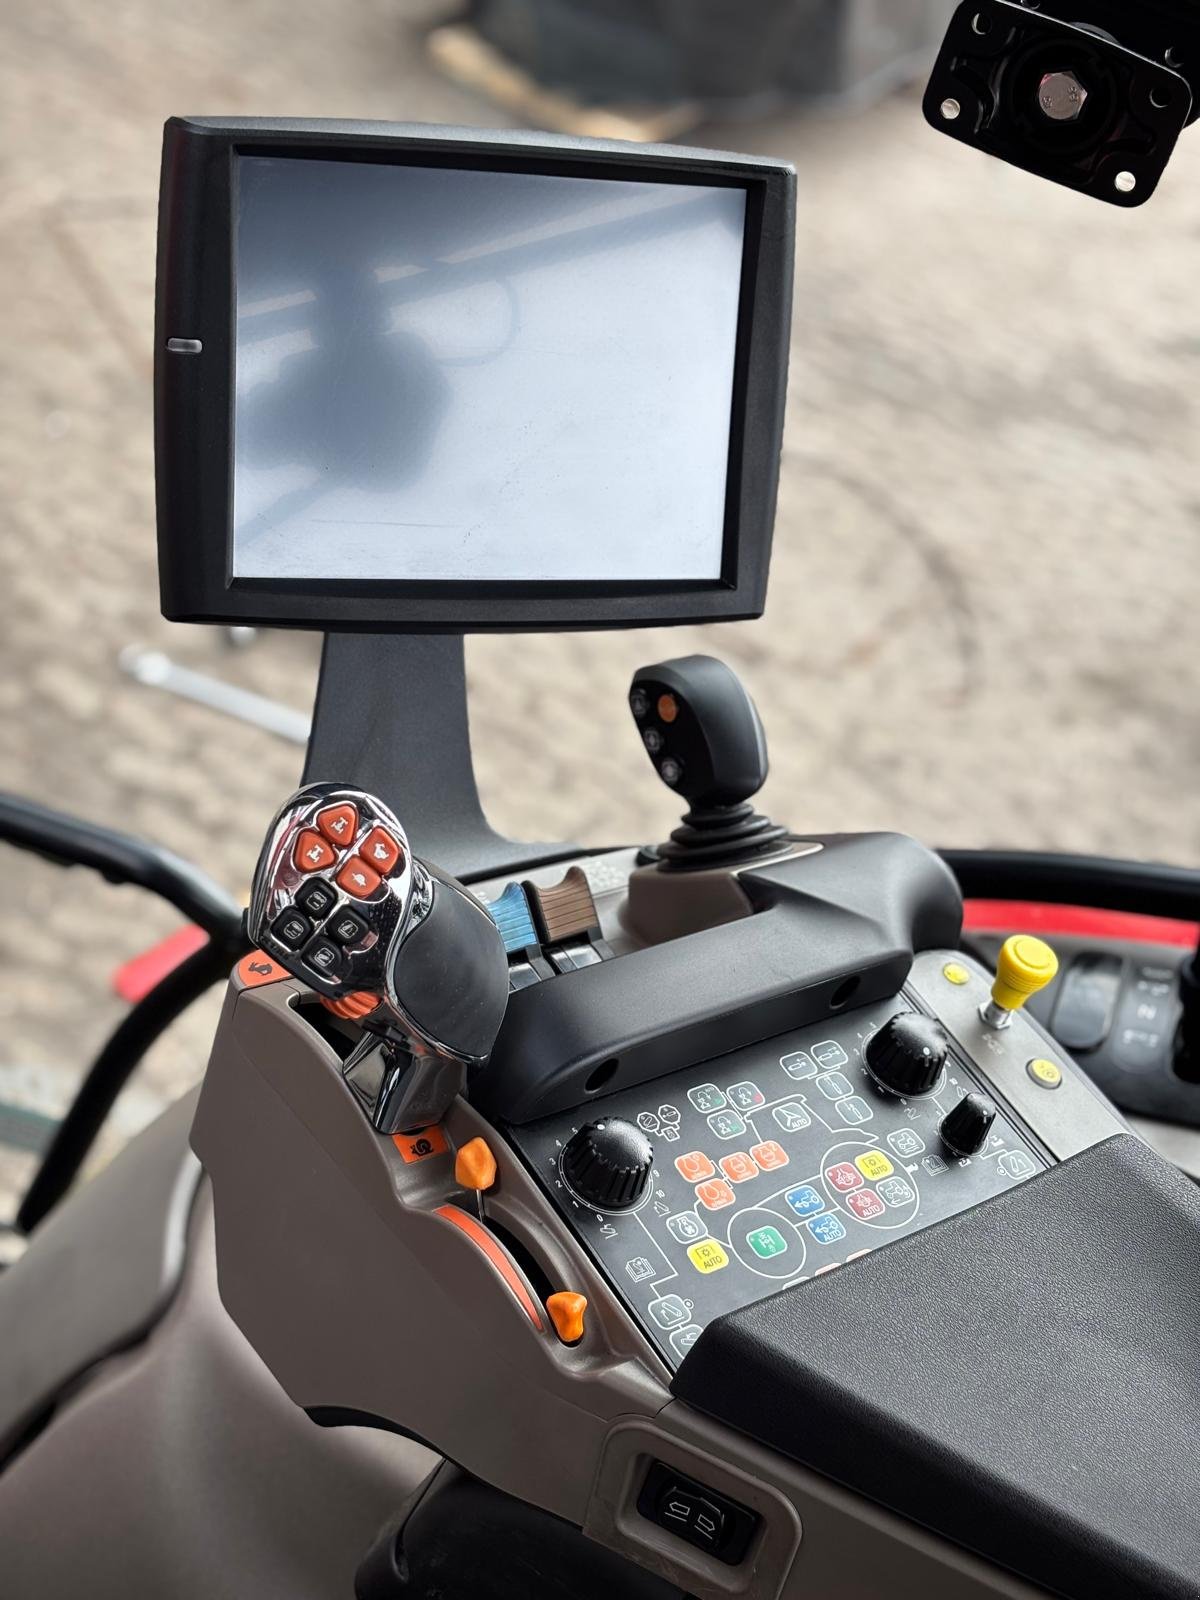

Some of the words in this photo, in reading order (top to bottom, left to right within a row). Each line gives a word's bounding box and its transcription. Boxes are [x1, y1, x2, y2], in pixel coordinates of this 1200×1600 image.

[791, 1118, 808, 1129] AUTO
[549, 1157, 556, 1166] 3
[870, 1164, 888, 1177] AUTO
[555, 1180, 563, 1188] 2
[572, 1200, 579, 1208] 1
[862, 1204, 881, 1217] AUTO
[823, 1229, 842, 1241] AUTO
[703, 1255, 723, 1269] AUTO
